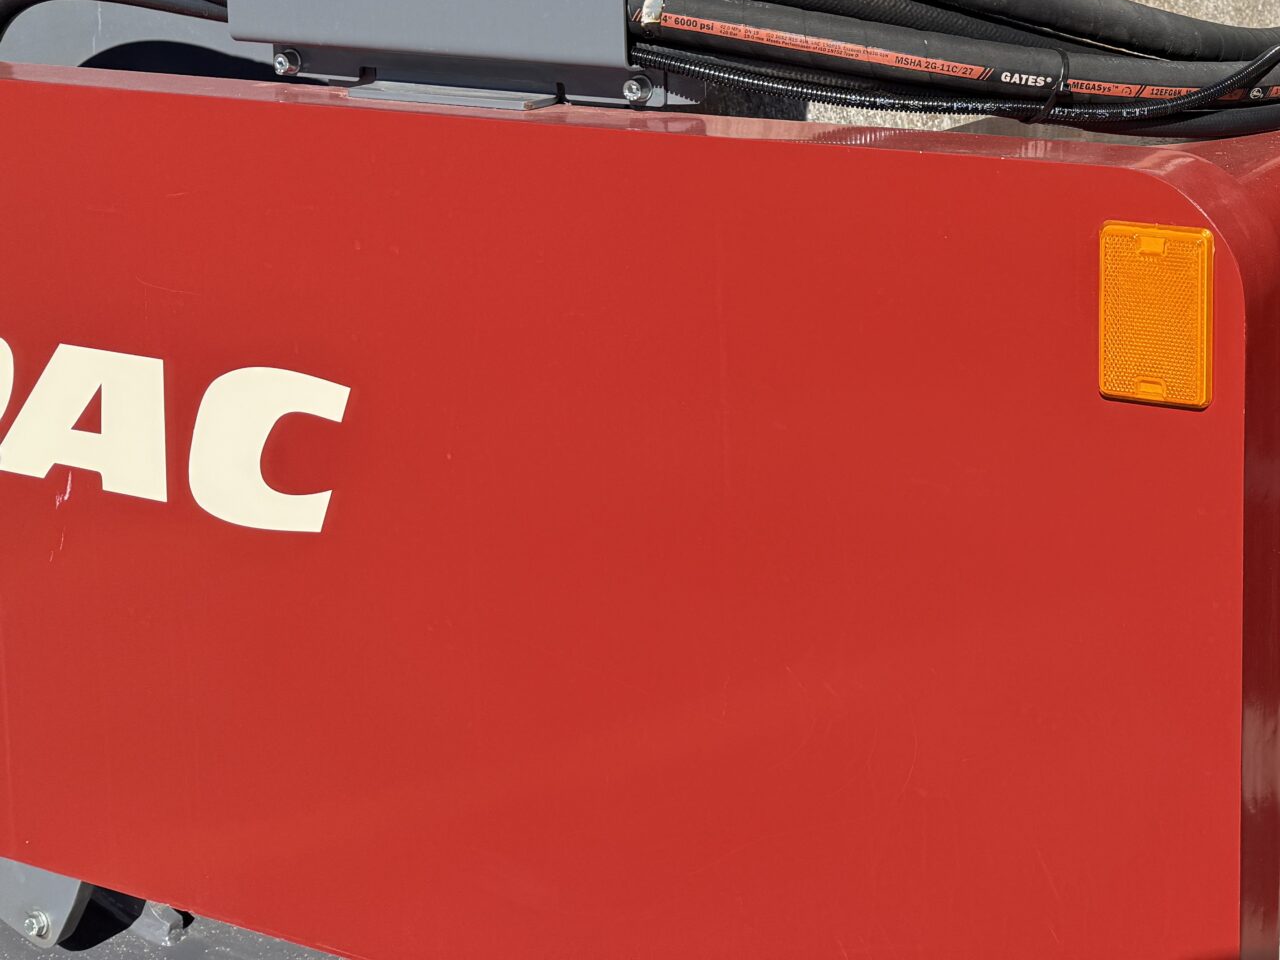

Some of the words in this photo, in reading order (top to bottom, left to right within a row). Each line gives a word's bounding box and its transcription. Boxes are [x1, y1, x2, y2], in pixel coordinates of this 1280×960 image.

[674, 17, 698, 27] 6000
[700, 22, 714, 31] psi
[895, 55, 922, 69] MSHA
[924, 61, 974, 76] 2G-11C/27
[0, 337, 351, 533] AC
